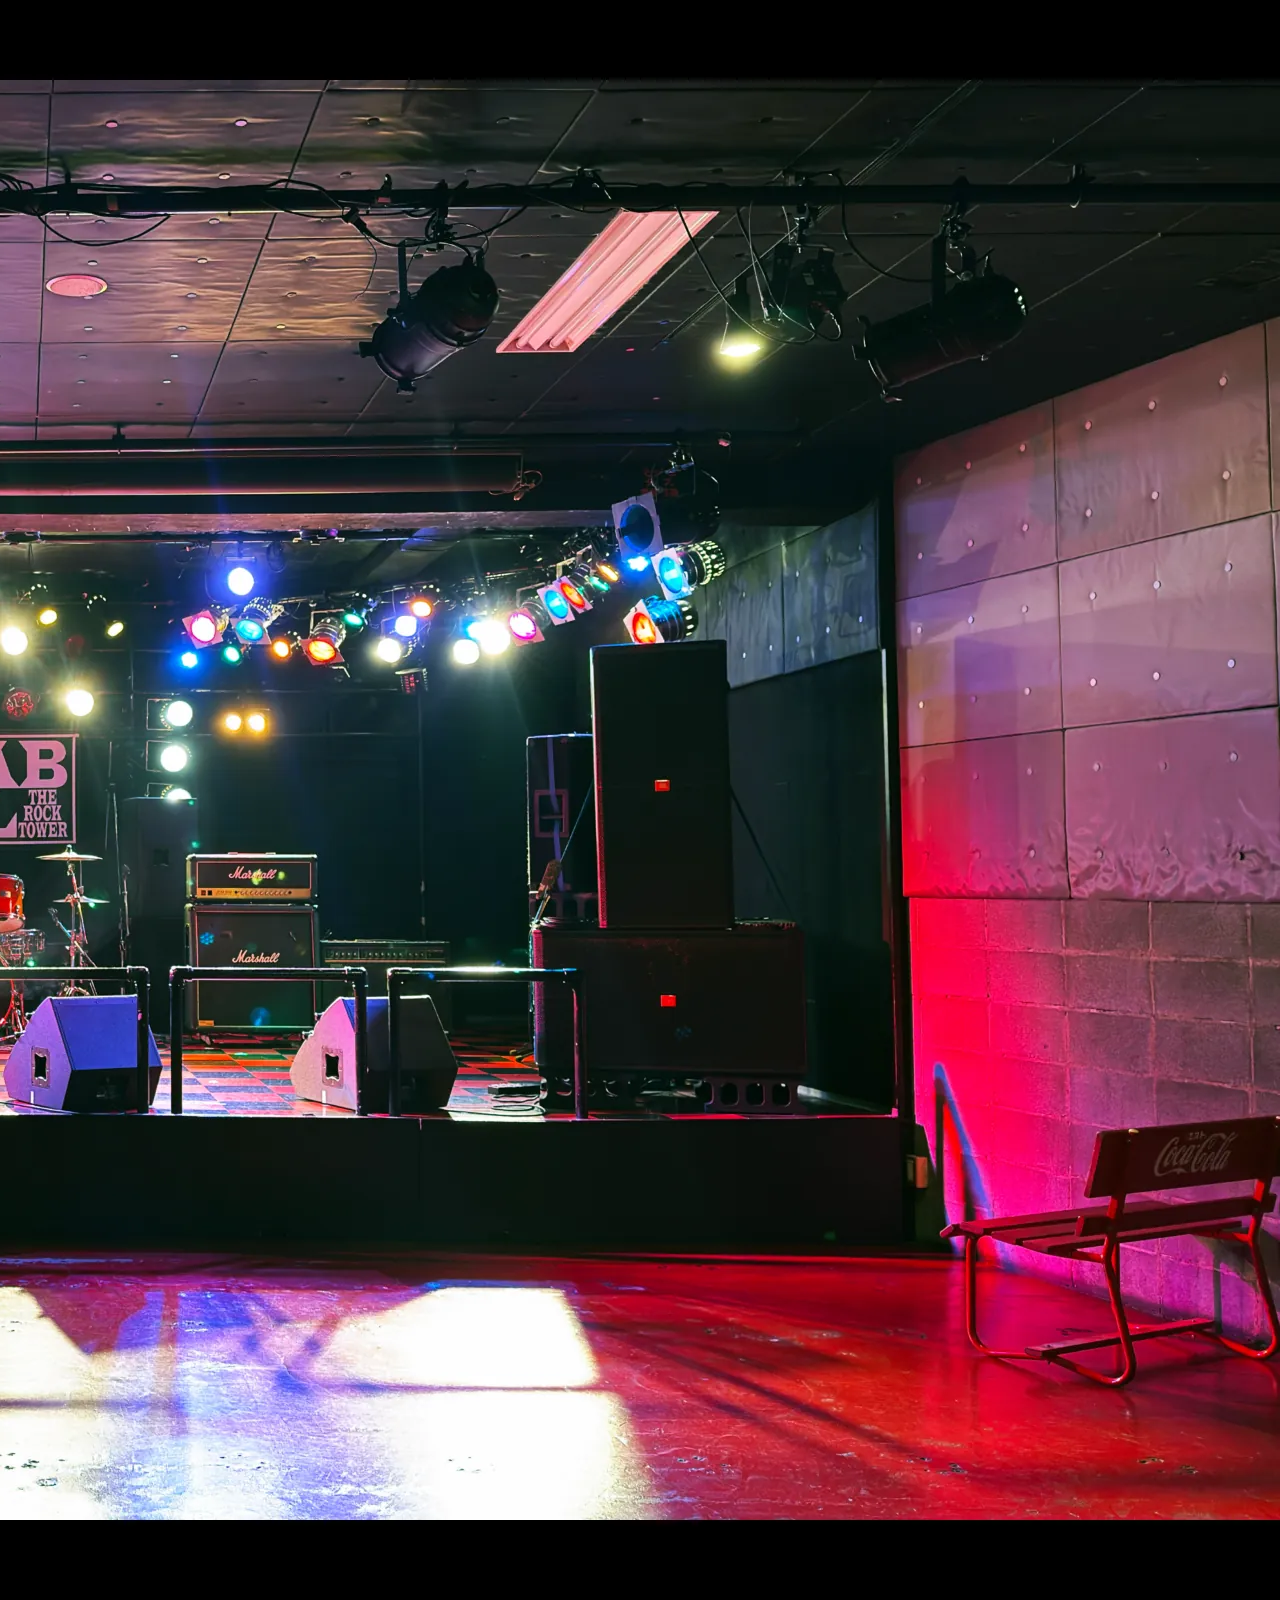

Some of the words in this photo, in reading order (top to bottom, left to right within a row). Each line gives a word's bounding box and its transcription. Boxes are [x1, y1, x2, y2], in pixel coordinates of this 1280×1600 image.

[28, 789, 57, 805] THE
[23, 805, 62, 821] ROCK
[19, 822, 68, 838] TOWER
[228, 866, 278, 880] Marshall
[231, 950, 280, 963] Marshall
